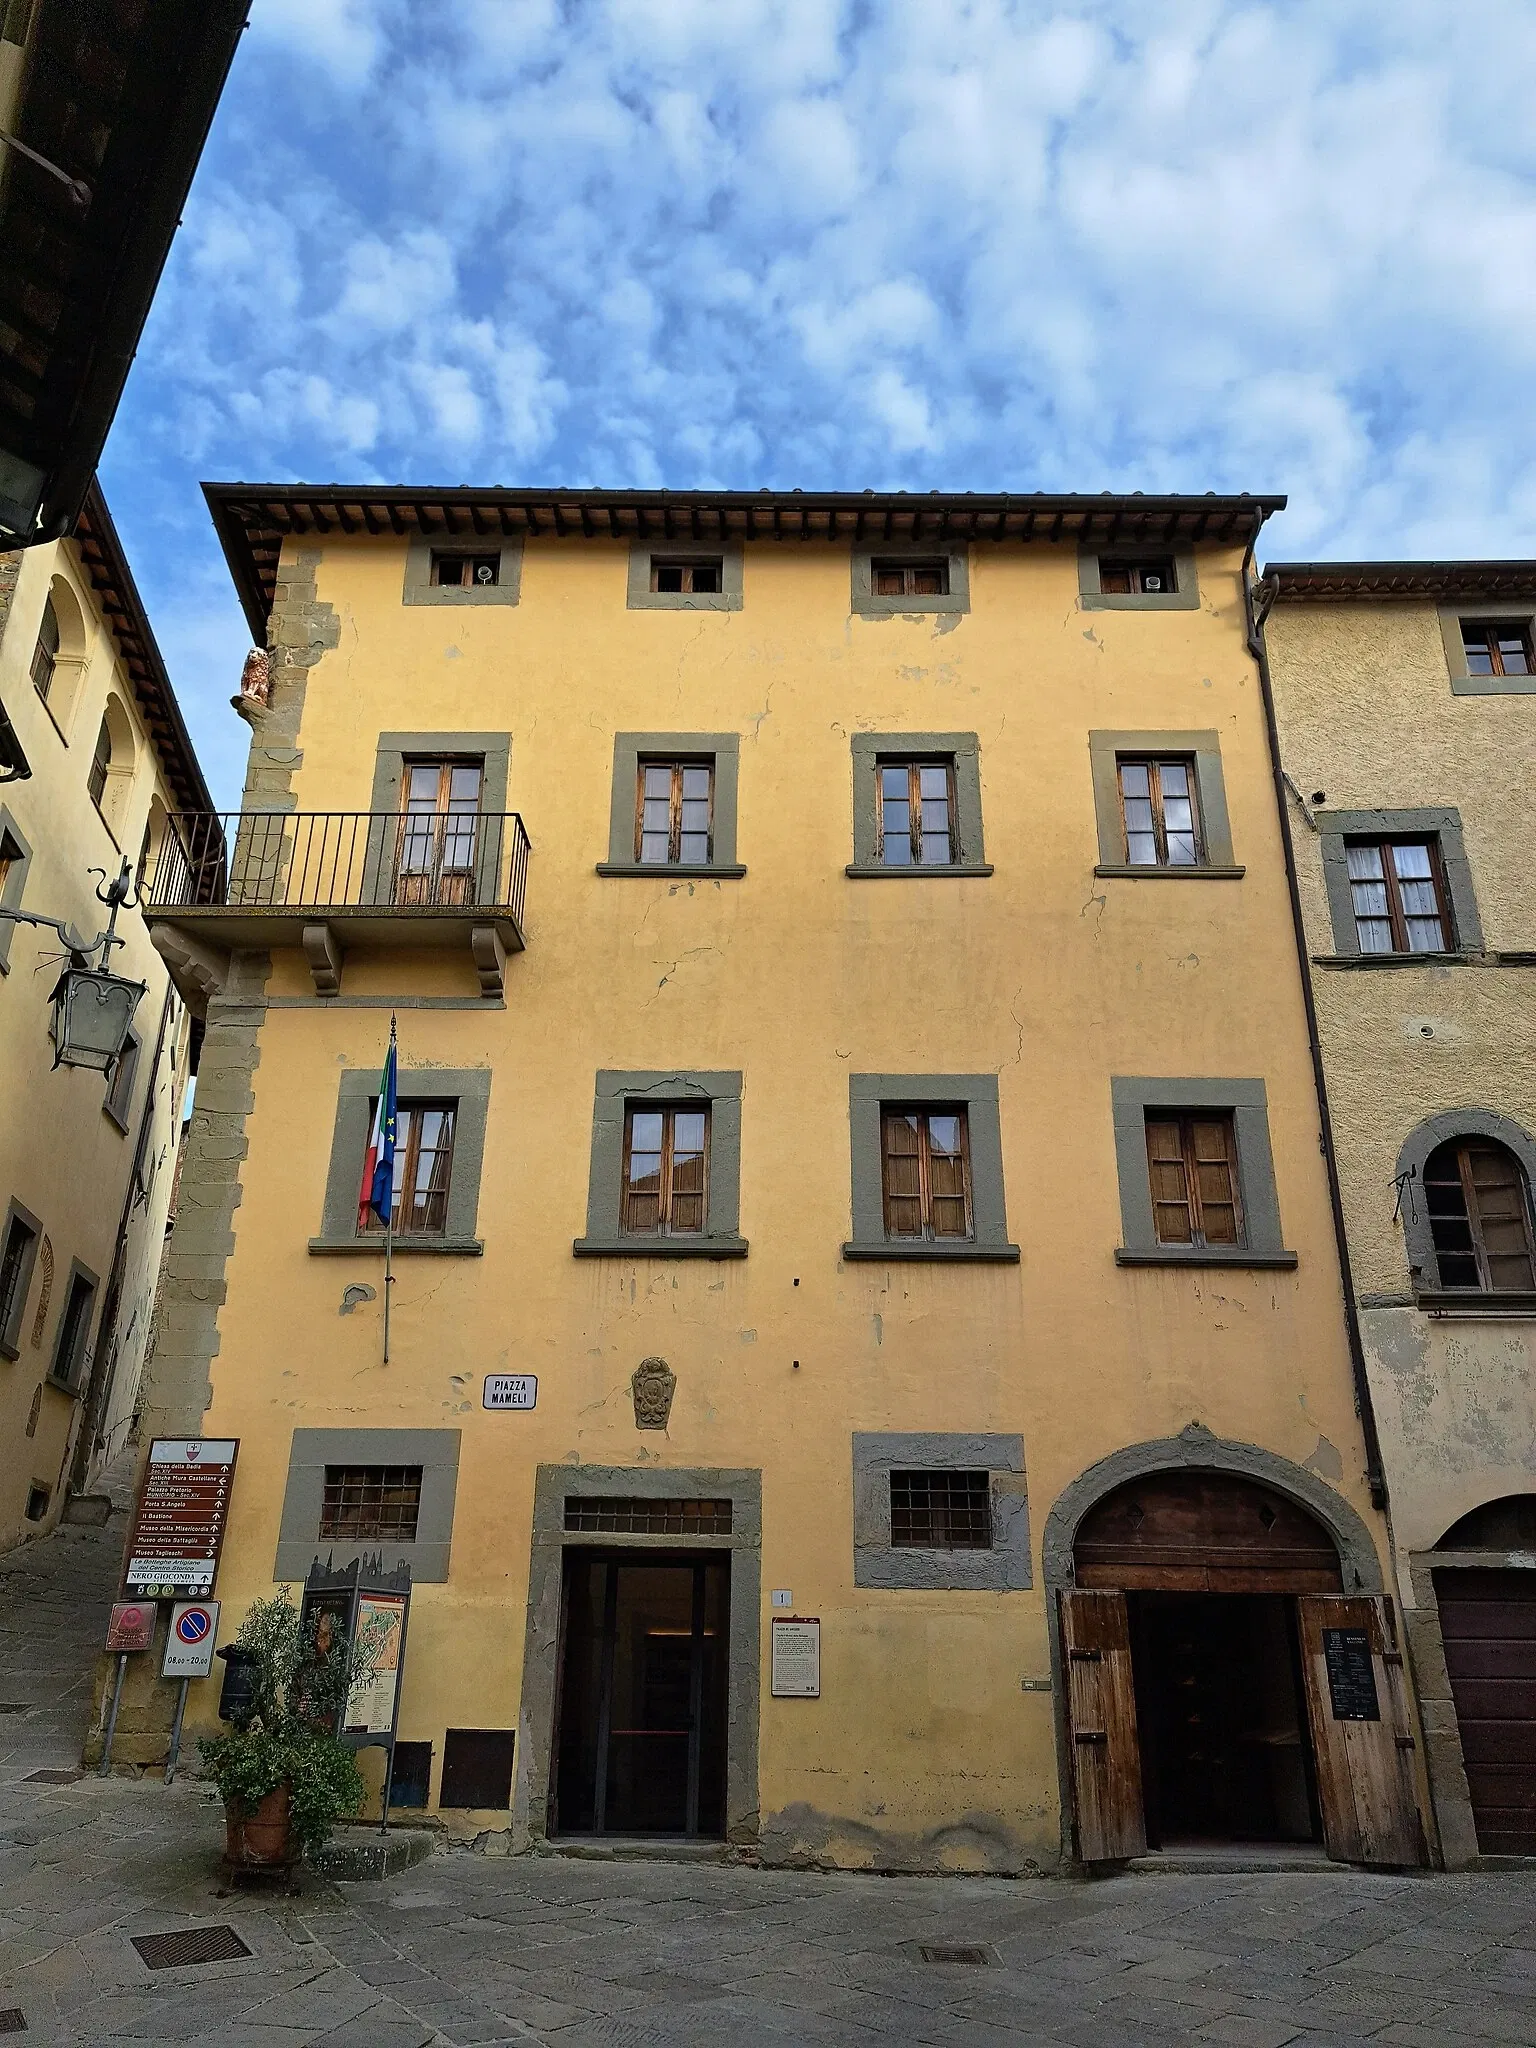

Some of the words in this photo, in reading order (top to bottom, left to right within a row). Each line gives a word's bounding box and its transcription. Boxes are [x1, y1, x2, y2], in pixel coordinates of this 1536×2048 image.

[494, 1380, 526, 1391] PIAZZA
[491, 1393, 527, 1404] MAMELI
[780, 1593, 785, 1604] 1
